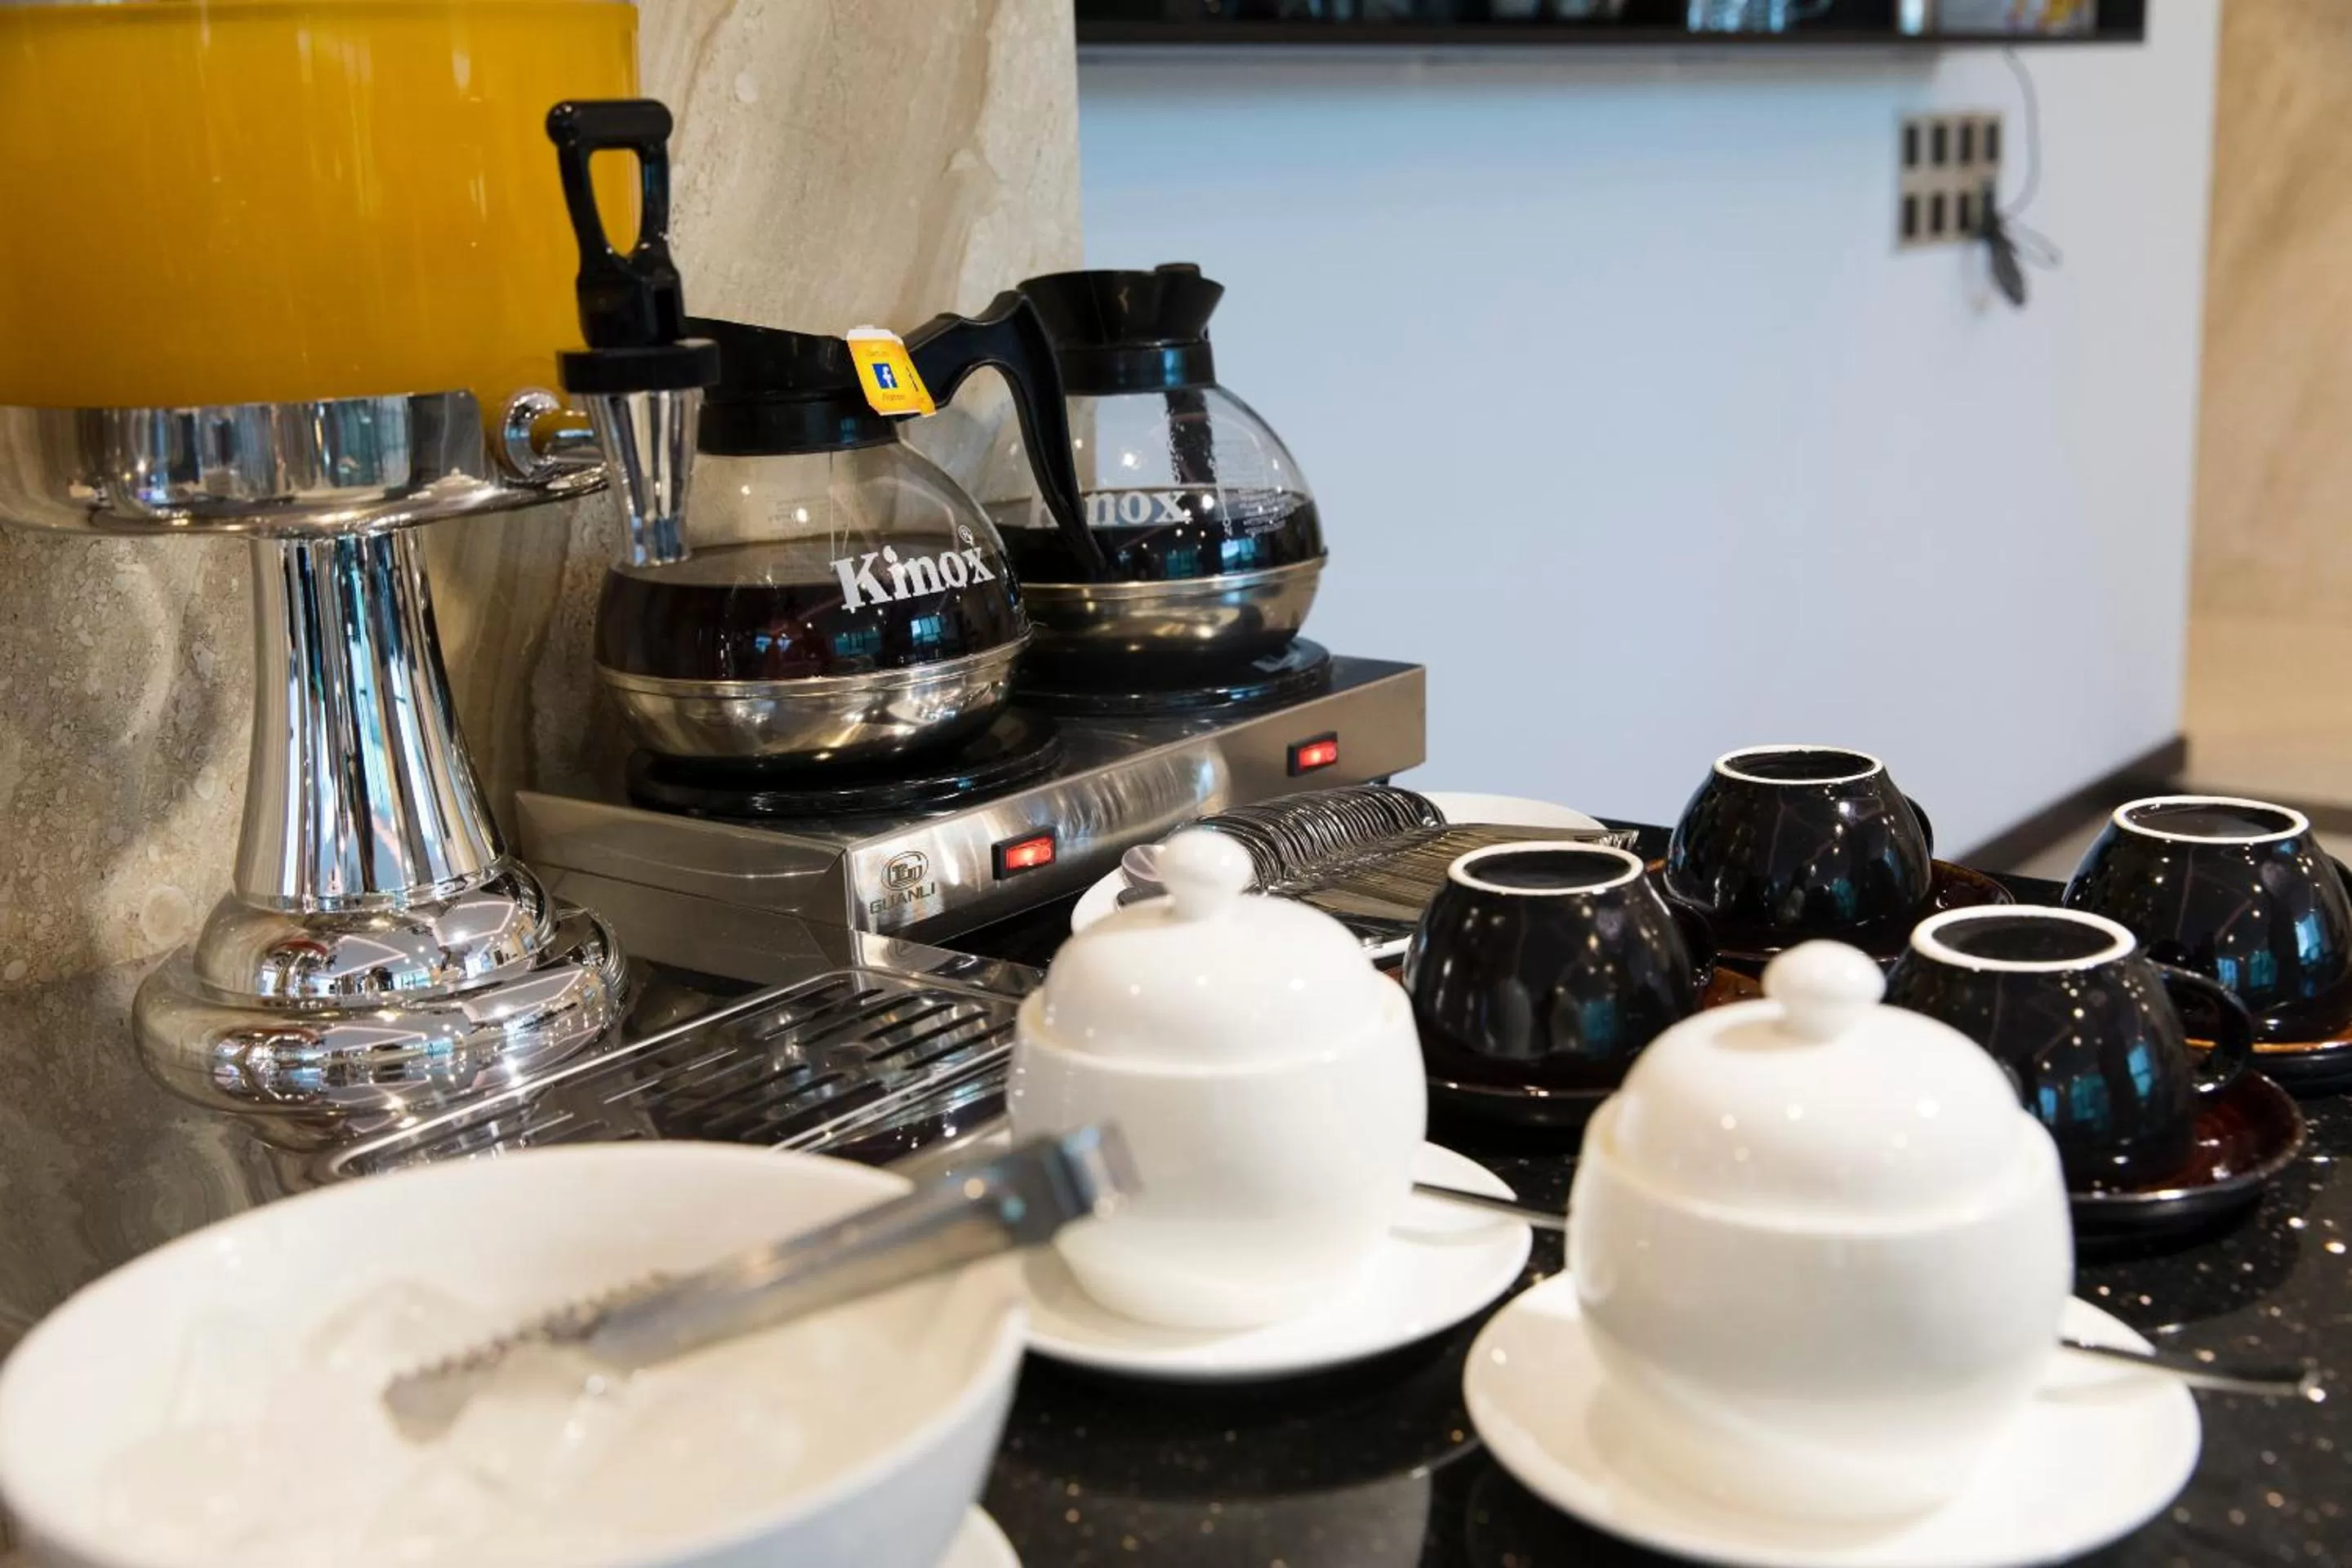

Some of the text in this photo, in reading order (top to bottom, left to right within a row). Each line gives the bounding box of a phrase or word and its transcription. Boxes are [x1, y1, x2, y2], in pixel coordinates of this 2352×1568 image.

[1026, 483, 1192, 529] Knox
[830, 545, 996, 612] Kinox
[869, 881, 935, 915] GUANLI
